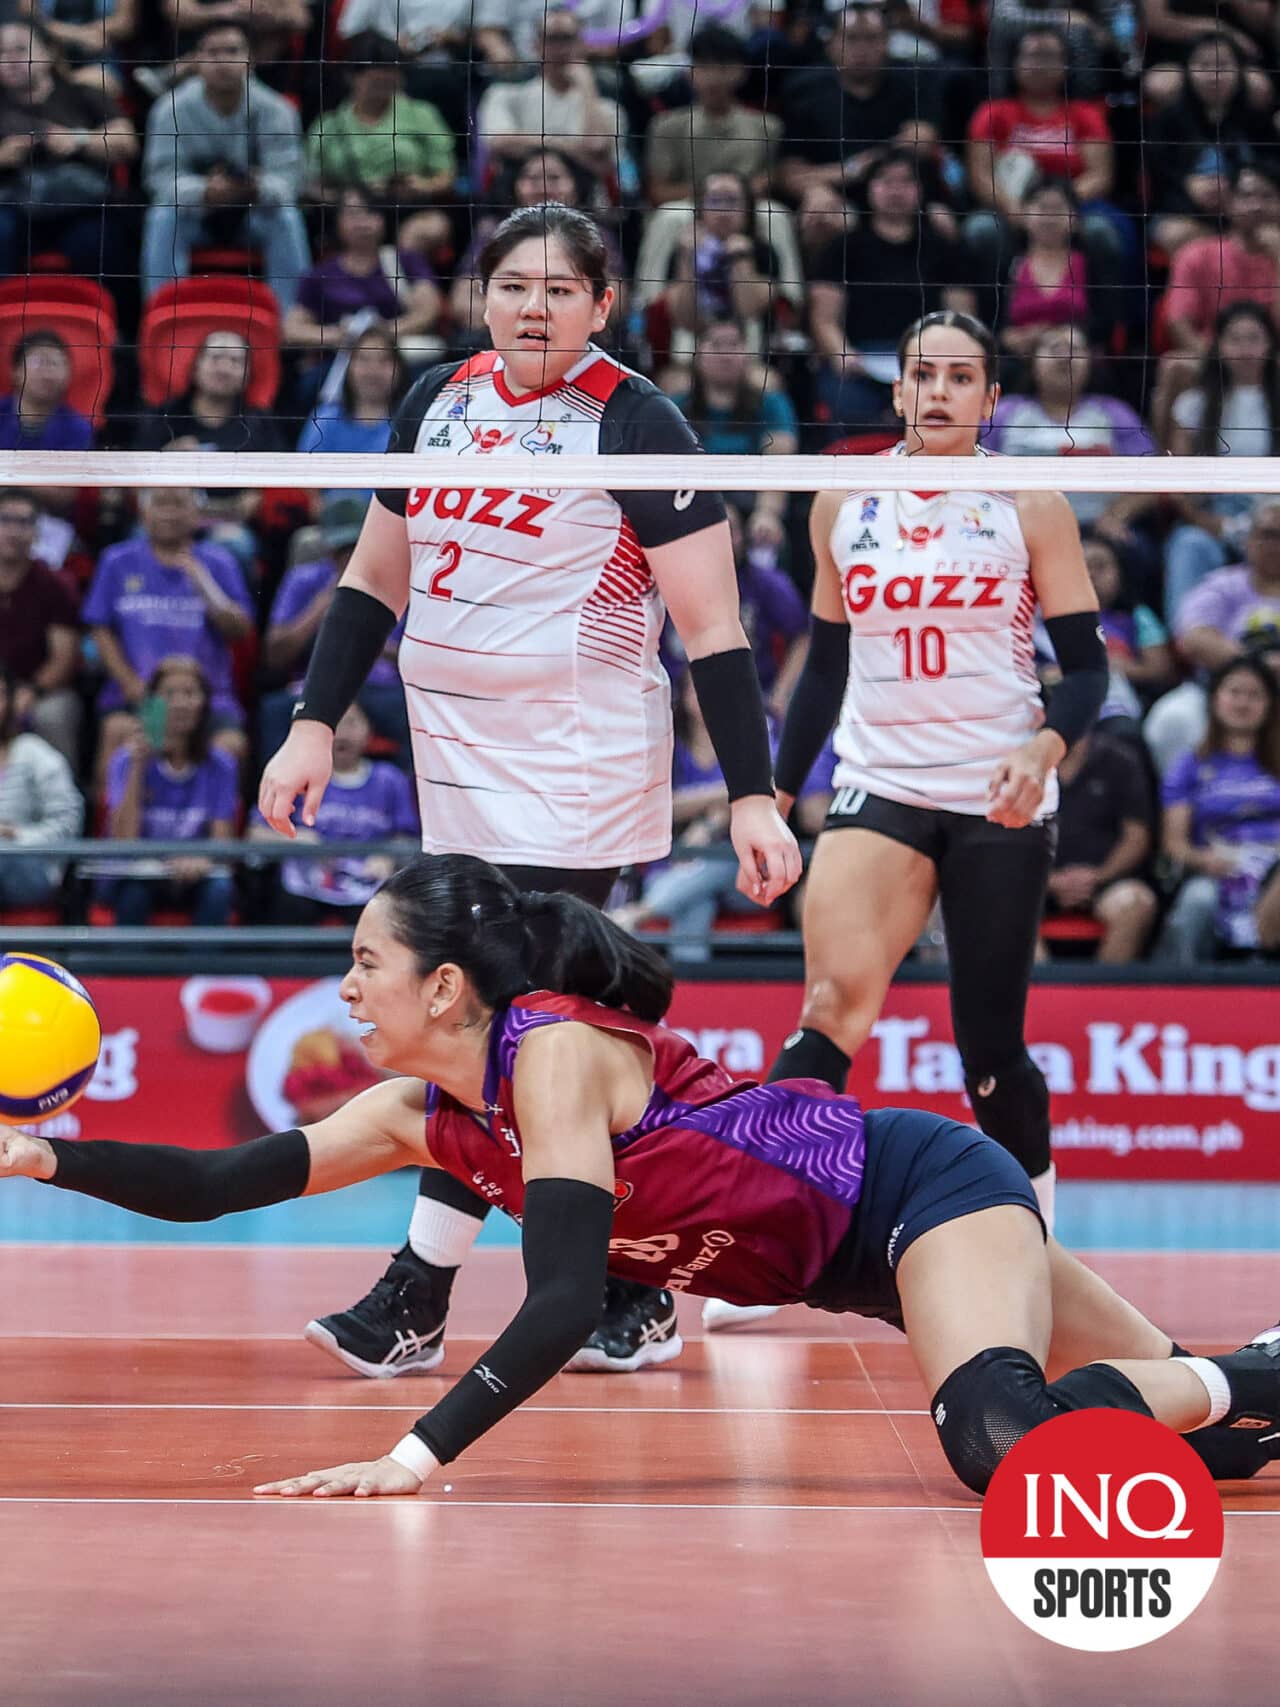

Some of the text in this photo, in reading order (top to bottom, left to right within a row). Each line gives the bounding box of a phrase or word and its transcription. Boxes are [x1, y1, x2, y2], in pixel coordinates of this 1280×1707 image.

[427, 540, 463, 603] 2
[845, 563, 1007, 615] Gazz
[892, 625, 948, 684] 10
[870, 1016, 1280, 1112] Taa King
